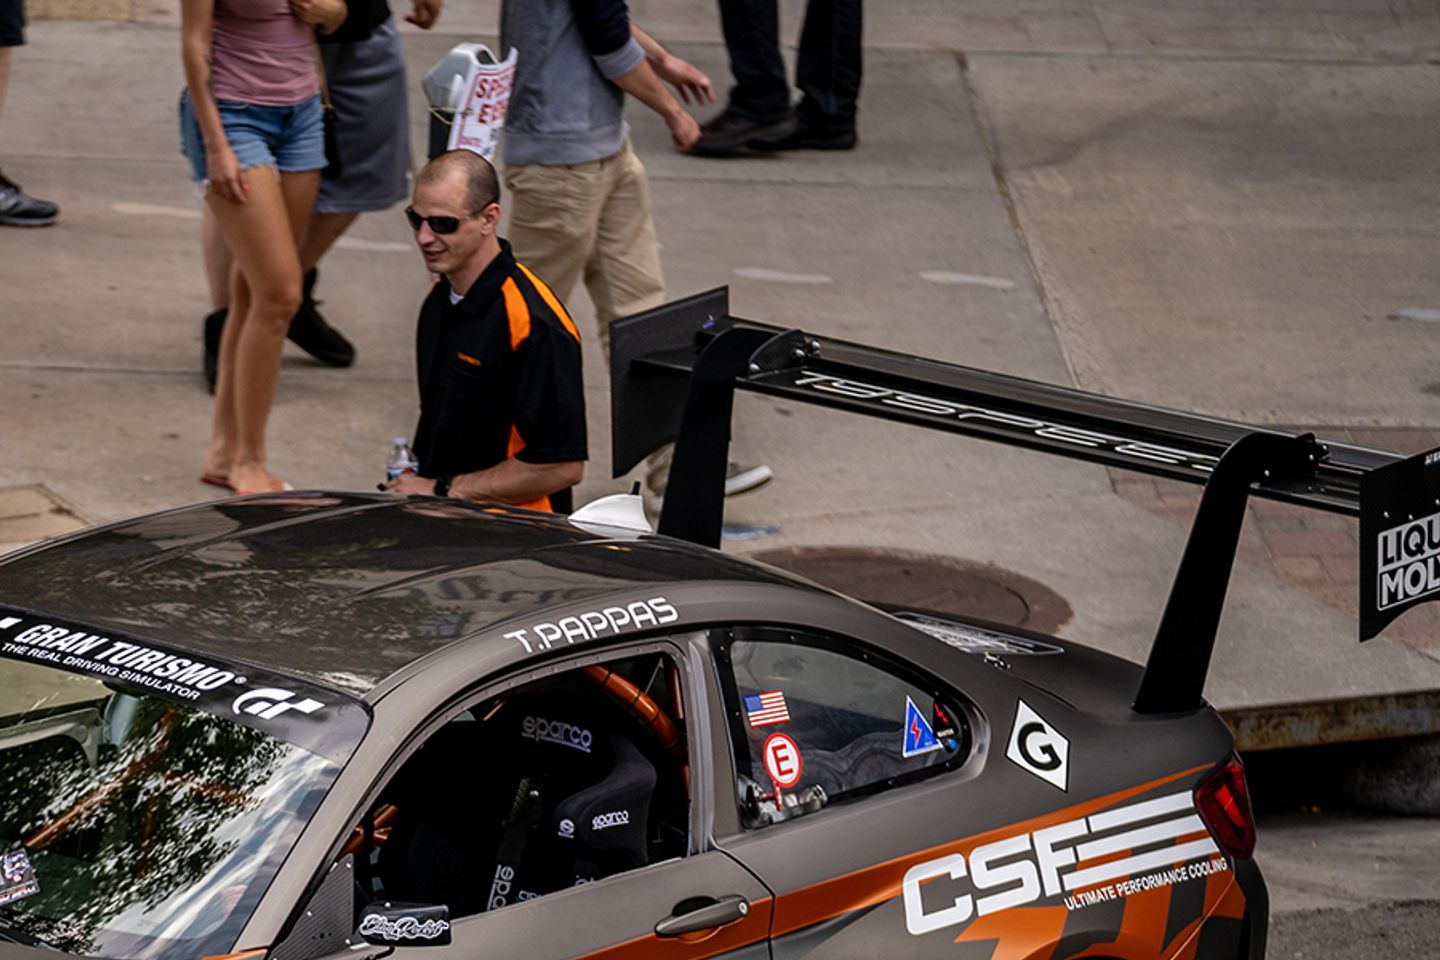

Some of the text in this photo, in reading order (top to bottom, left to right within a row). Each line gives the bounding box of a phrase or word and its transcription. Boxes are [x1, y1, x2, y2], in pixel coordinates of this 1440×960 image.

[14, 624, 109, 661] GRAN
[2, 643, 201, 701] THE REAL DRIVING SIMULATOR
[521, 715, 593, 752] sparco
[1017, 721, 1062, 771] G
[772, 743, 793, 777] E
[592, 810, 630, 830] sparco
[903, 815, 1092, 936] CSF
[1063, 857, 1229, 911] ULTIMATE PERFORMANCE COOLING
